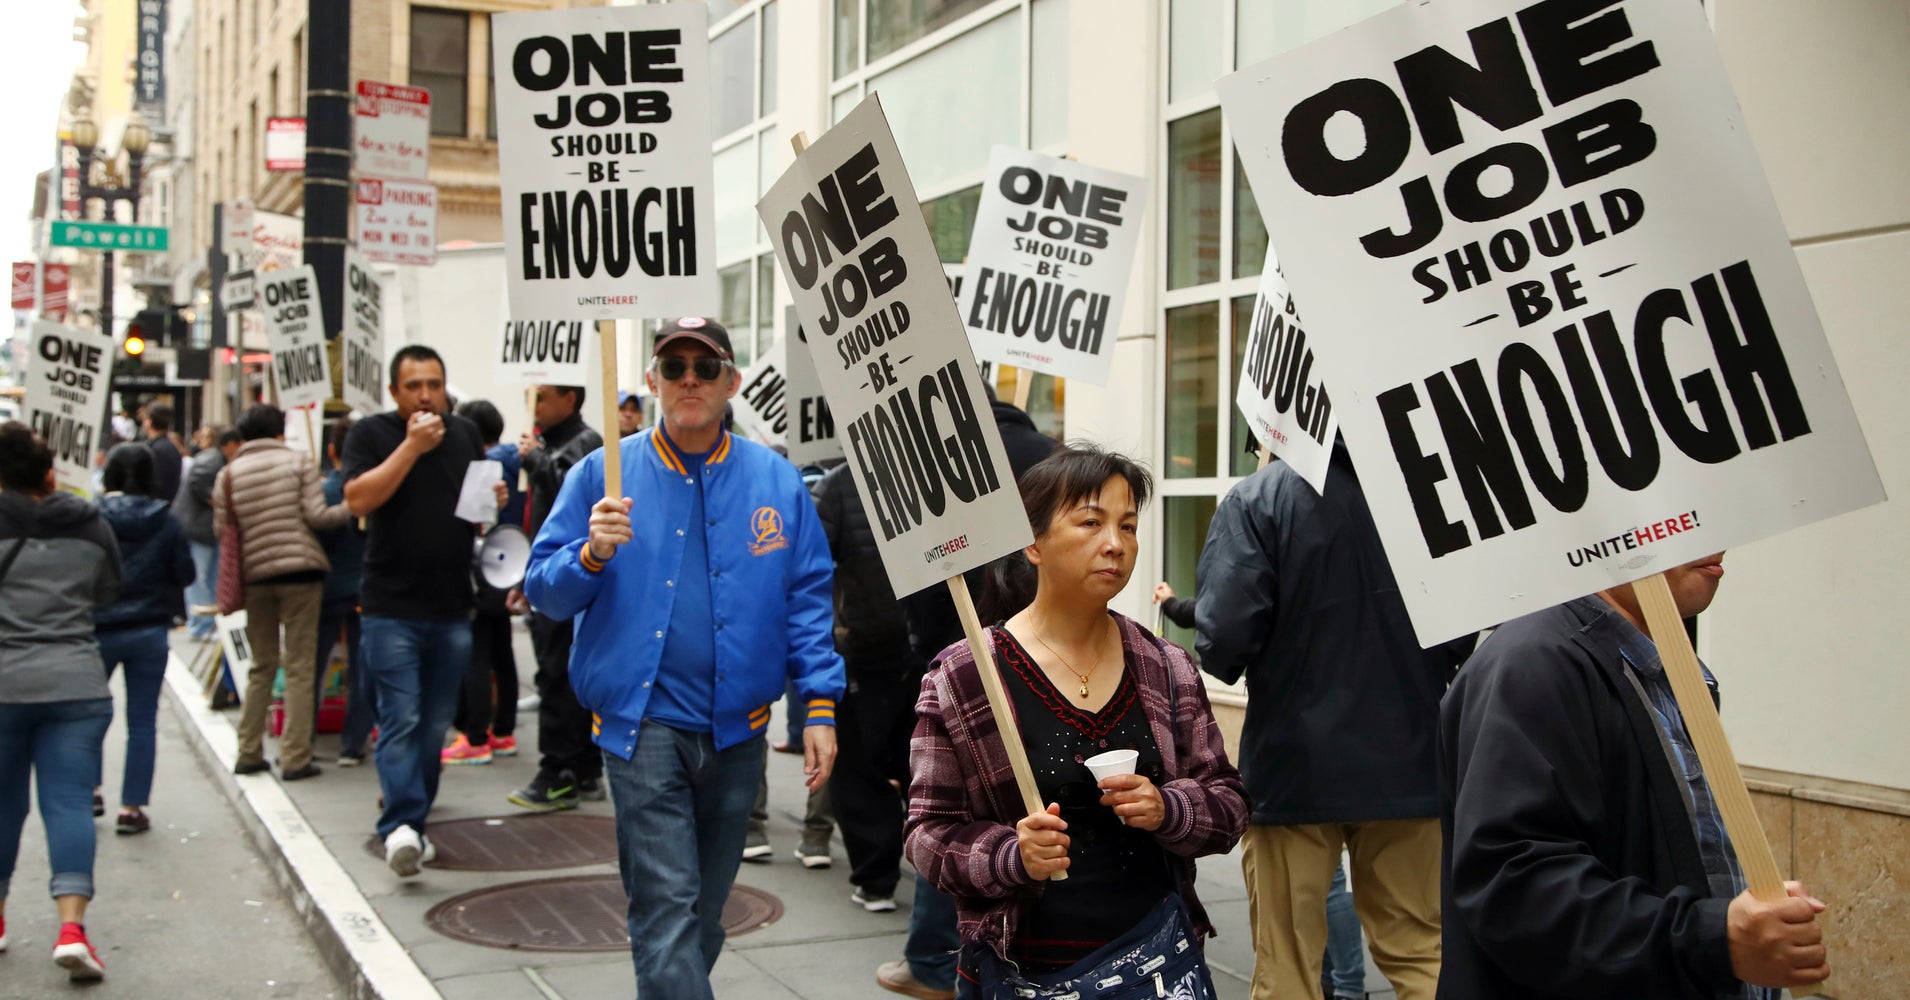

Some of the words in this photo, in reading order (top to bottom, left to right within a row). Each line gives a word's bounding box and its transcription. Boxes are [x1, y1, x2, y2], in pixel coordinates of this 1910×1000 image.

[513, 29, 684, 91] ONE
[533, 90, 672, 129] JOB
[1281, 0, 1661, 197] ONE
[551, 132, 657, 157] SHOULD
[588, 161, 620, 183] BE
[1359, 98, 1657, 259] JOB
[360, 182, 378, 203] NO
[386, 188, 433, 208] PARKING
[781, 142, 900, 290] ONE
[999, 165, 1128, 227] ONE
[65, 226, 156, 247] Powell
[364, 231, 383, 243] MON
[520, 186, 697, 280] ENOUGH
[1006, 211, 1109, 250] JOB
[1013, 236, 1093, 267] SHOULD
[1411, 187, 1645, 304] SHOULD
[349, 263, 381, 310] ONE
[818, 236, 908, 336] JOB
[1036, 260, 1063, 279] BE
[265, 277, 310, 306] ONE
[577, 296, 638, 305] UNITEHERE!
[968, 266, 1111, 356] ENOUGH
[1507, 263, 1588, 328] BE
[274, 304, 309, 323] JOB
[836, 300, 911, 370] SHOULD
[39, 334, 102, 374] ONE
[502, 320, 582, 363] ENOUGH
[45, 367, 93, 391] JOB
[276, 343, 324, 390] ENOUGH
[867, 352, 898, 394] BE
[1376, 259, 1812, 559] ENOUGH
[847, 359, 1001, 542] ENOUGH
[924, 534, 970, 563] UNITEHERE!
[1566, 510, 1700, 567] UNITEHERE!
